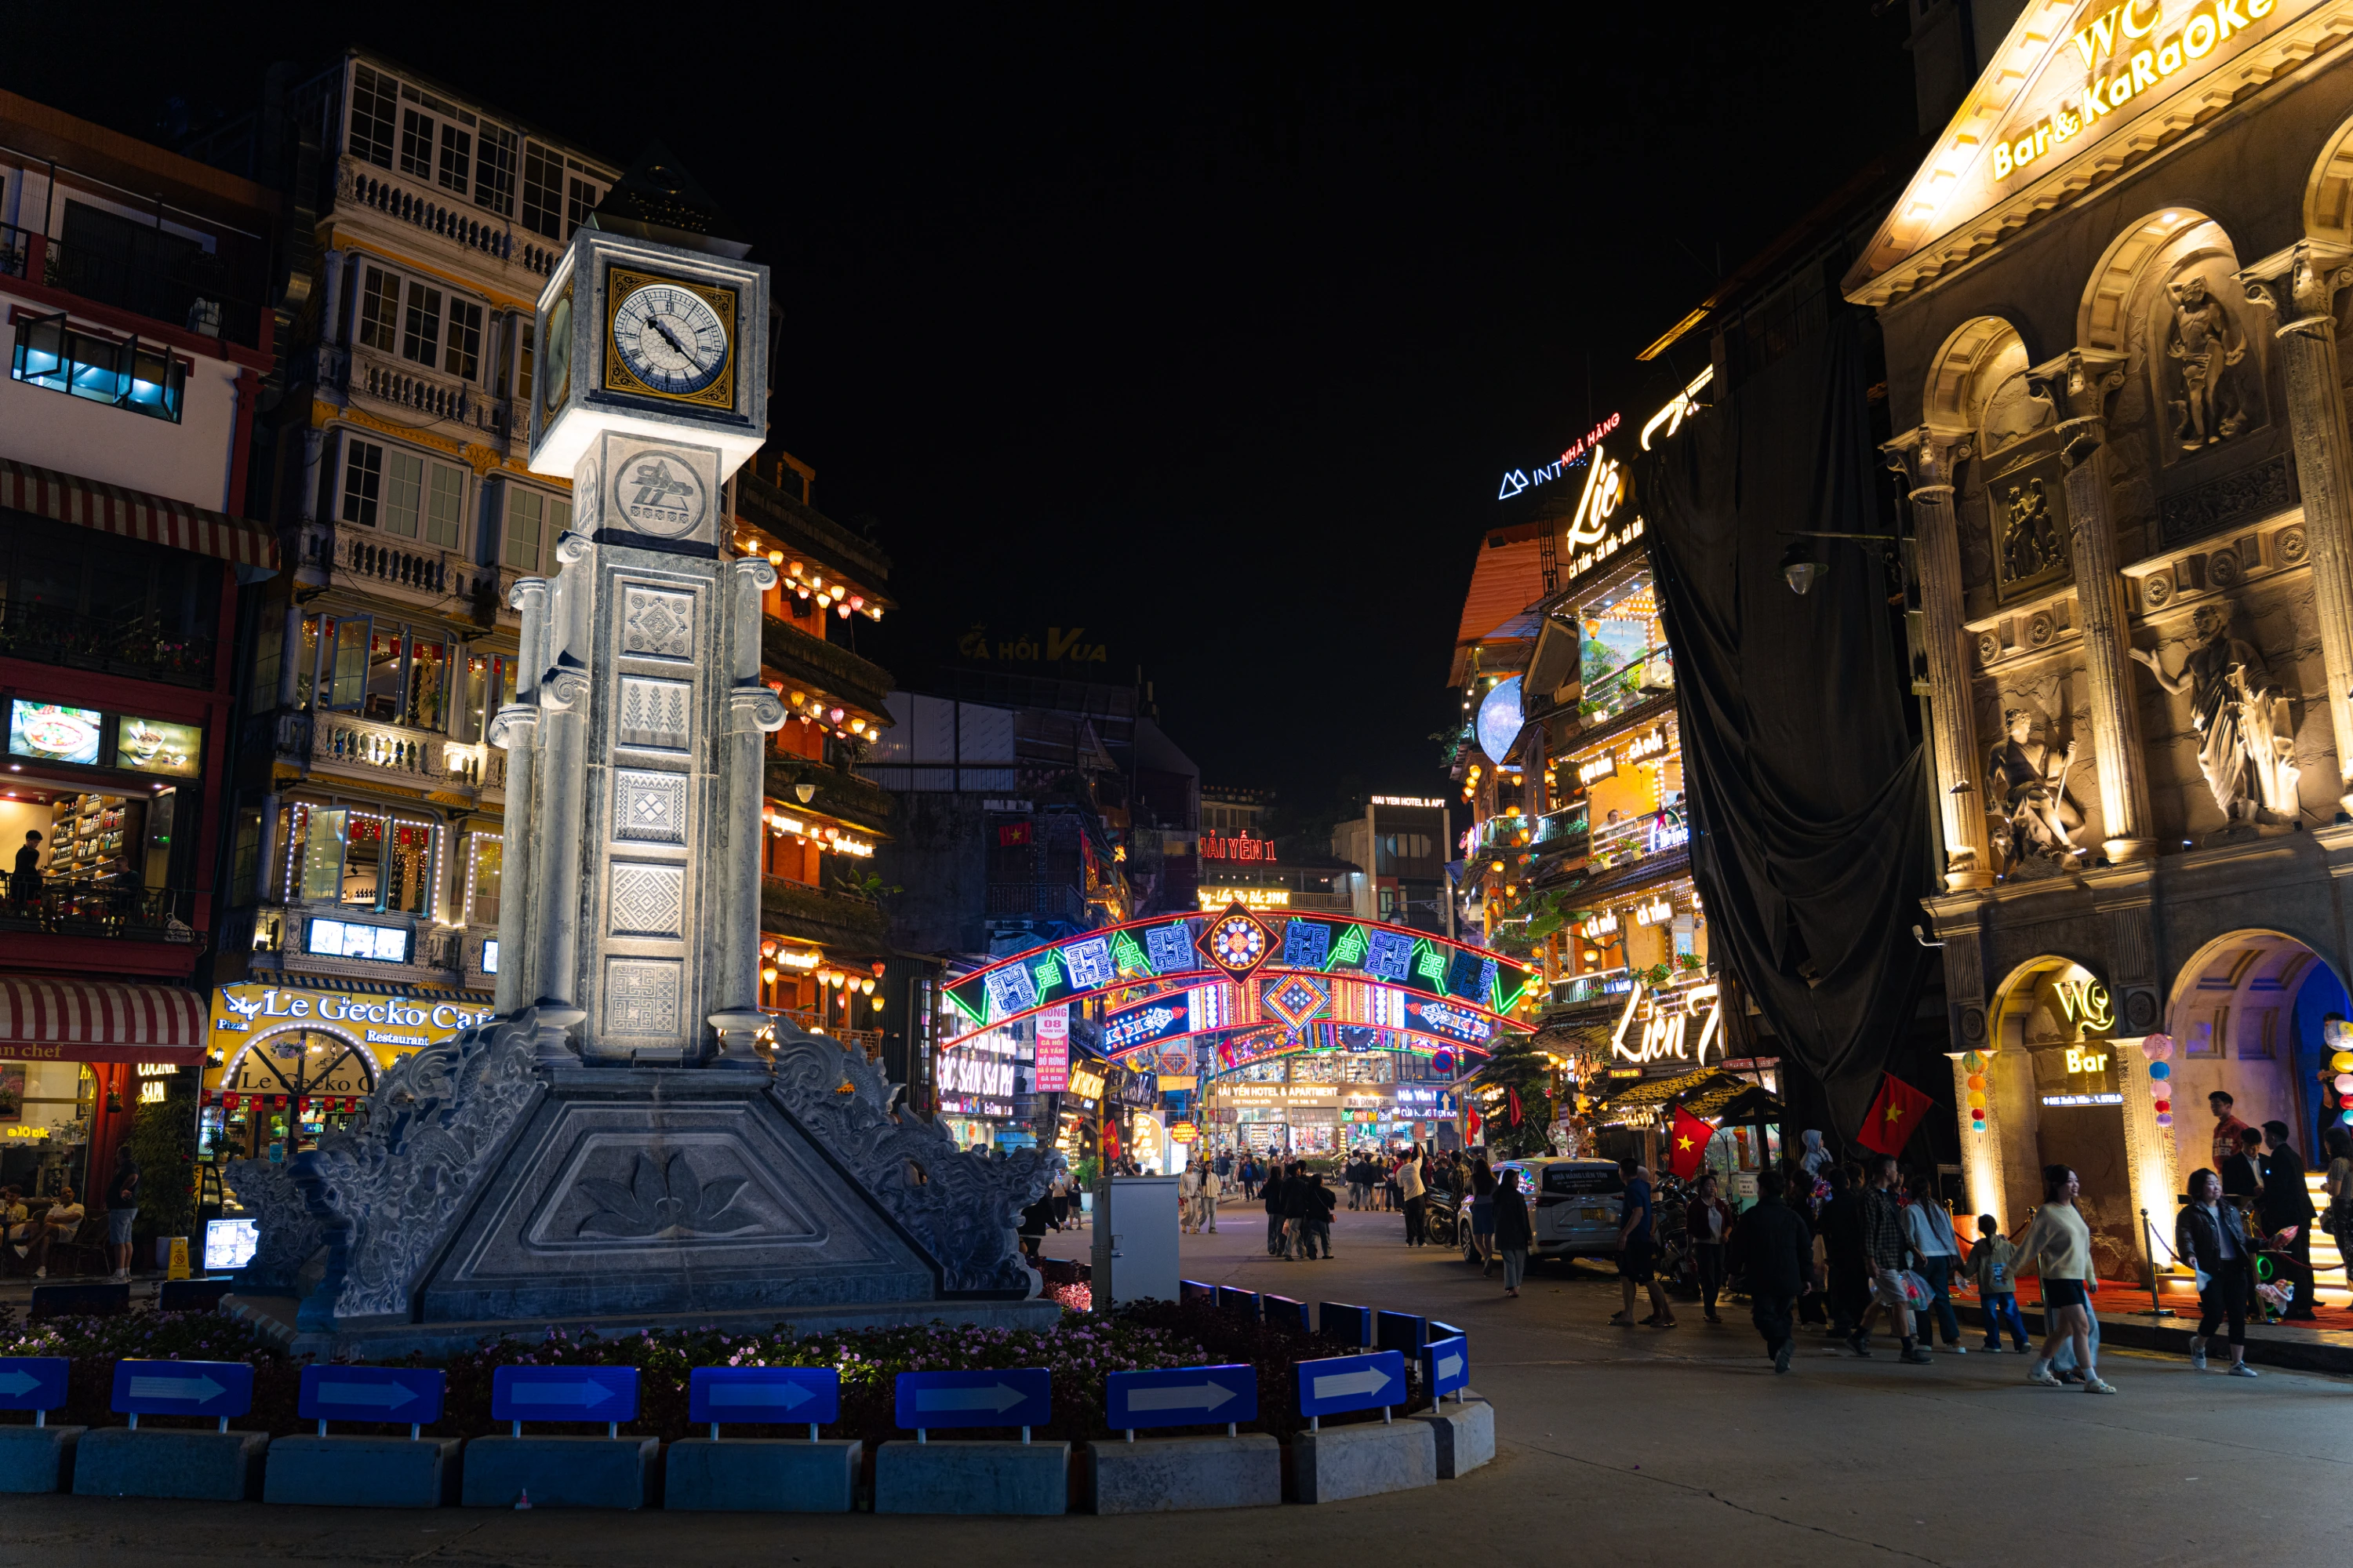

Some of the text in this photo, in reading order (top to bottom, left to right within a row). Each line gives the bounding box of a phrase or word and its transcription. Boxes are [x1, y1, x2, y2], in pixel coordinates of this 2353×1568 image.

[1992, 126, 2051, 181] Bar
[2053, 112, 2082, 144] &
[1562, 413, 1620, 467] NHÀ HÀNG
[1046, 627, 1107, 663] VUA
[1401, 797, 1424, 806] HOTEL
[1424, 798, 1430, 807] &
[1431, 799, 1446, 808] APT
[1227, 830, 1263, 860] YẾN
[1264, 840, 1277, 860] 1
[1659, 828, 1689, 848] Heine
[264, 991, 310, 1017] Le
[318, 997, 427, 1026] Gecko
[217, 1019, 249, 1031] Pizza
[1044, 1020, 1061, 1028] 08
[366, 1029, 430, 1047] Restaurant
[21, 1043, 64, 1058] chef
[2065, 1049, 2108, 1074] Bar
[242, 1071, 271, 1090] Le
[280, 1072, 351, 1092] Gecko
[983, 1061, 999, 1096] SA
[999, 1064, 1015, 1097] PA
[142, 1081, 165, 1103] SAPA
[1251, 1086, 1278, 1097] HOTEL
[1280, 1086, 1287, 1097] &
[1289, 1086, 1338, 1097] APARTMENT
